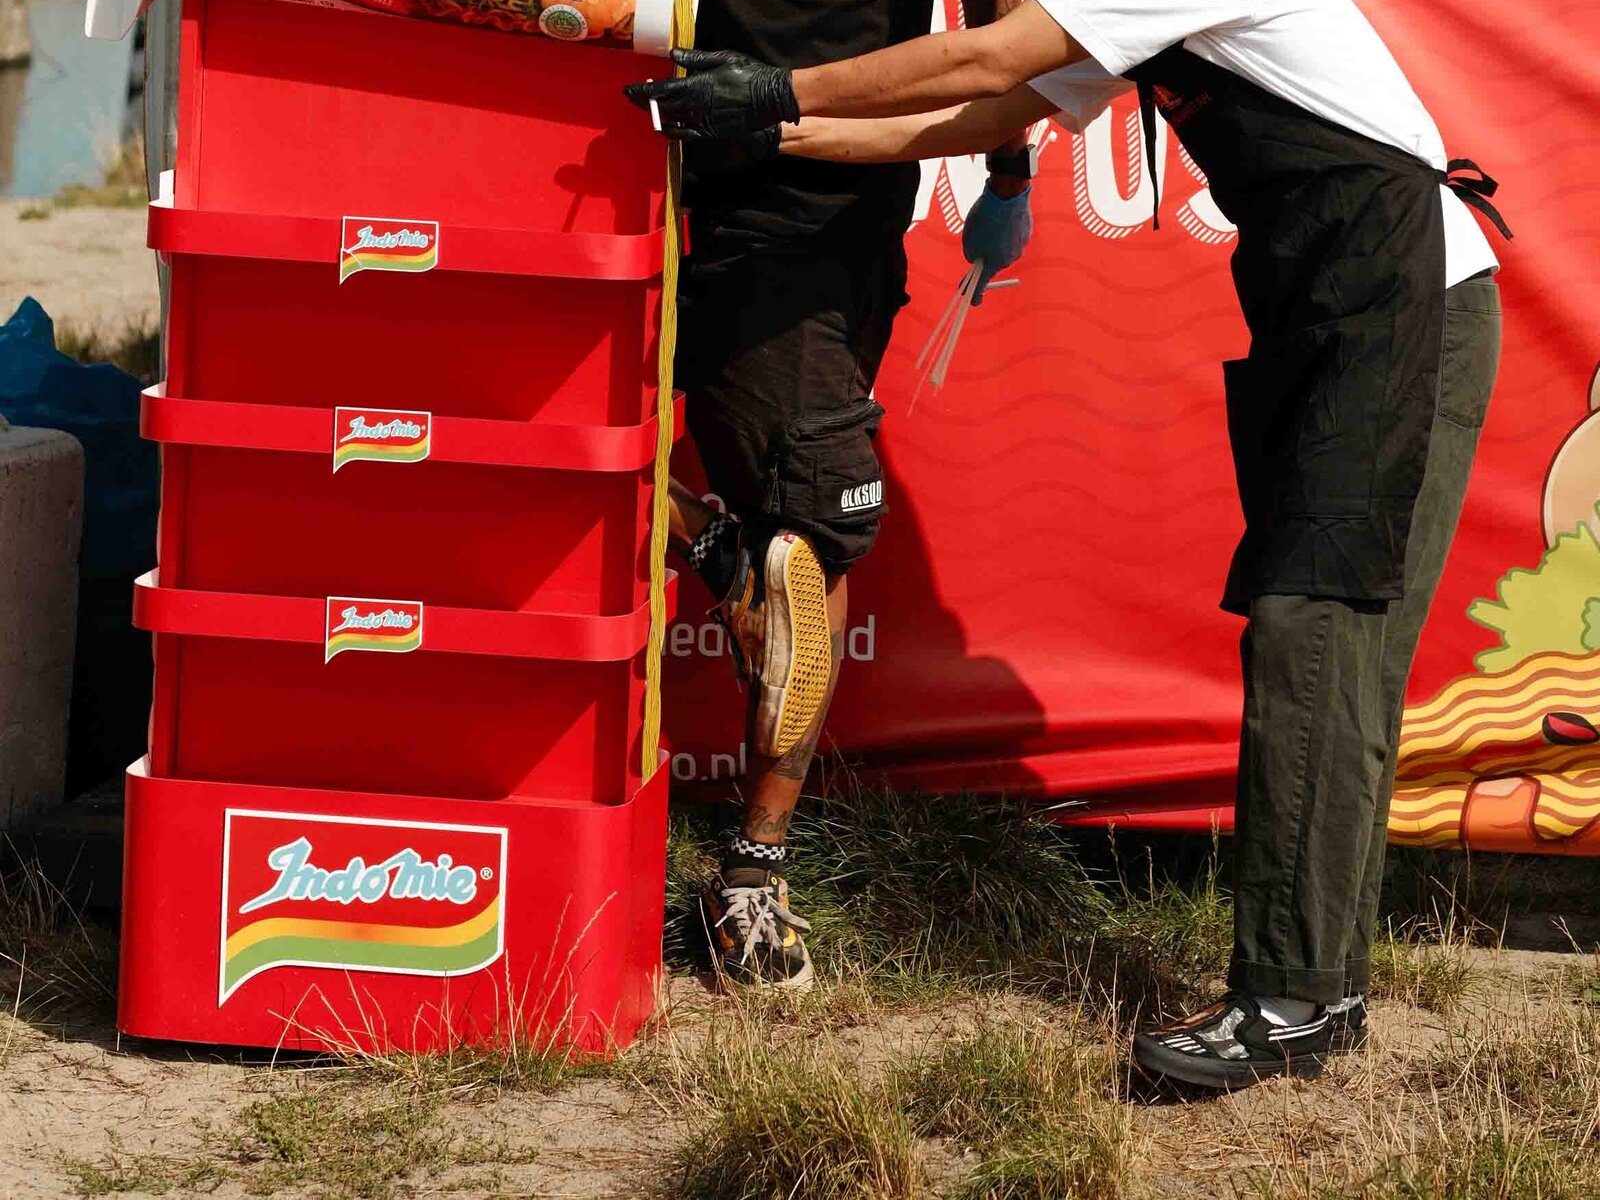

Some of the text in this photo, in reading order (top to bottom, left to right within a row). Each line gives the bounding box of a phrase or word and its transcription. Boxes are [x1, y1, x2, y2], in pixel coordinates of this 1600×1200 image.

[347, 225, 429, 254] Indomie
[339, 415, 421, 443] Indomie
[841, 479, 882, 509] BLKSQD
[331, 605, 413, 633] Indomie
[239, 835, 478, 915] Indomie
